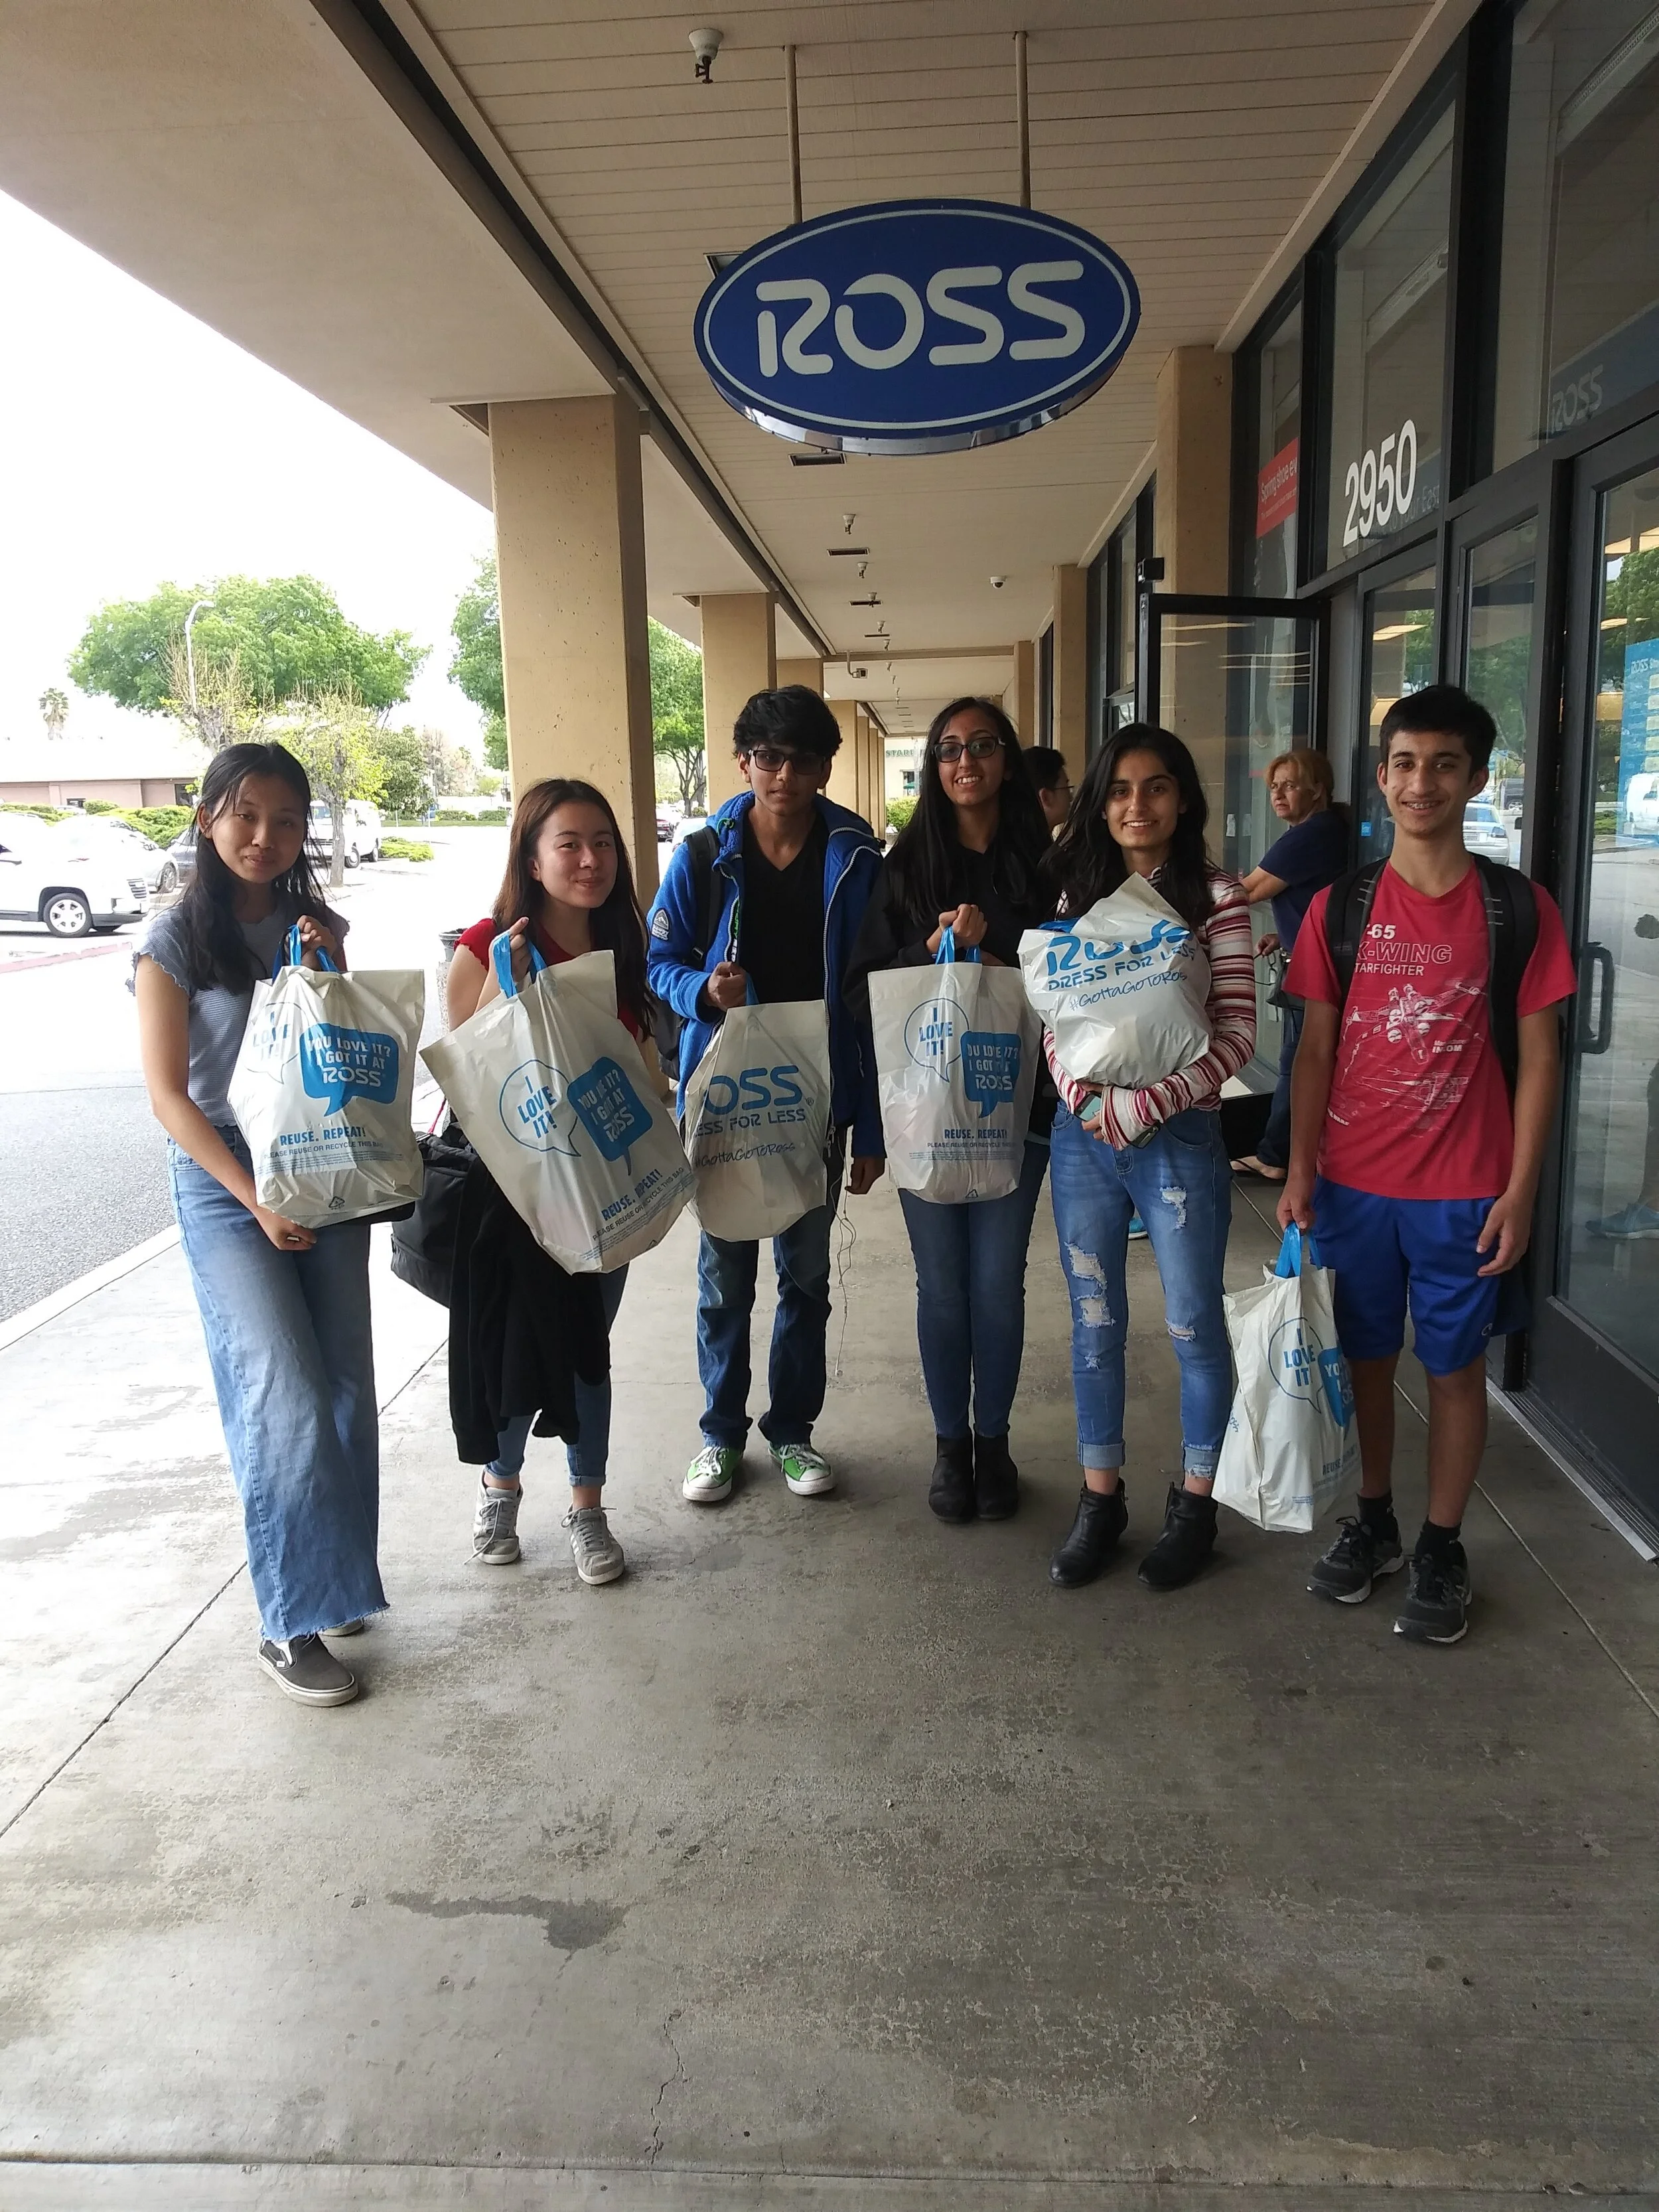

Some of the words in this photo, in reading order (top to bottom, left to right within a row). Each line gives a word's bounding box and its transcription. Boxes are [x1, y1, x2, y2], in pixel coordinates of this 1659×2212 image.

[756, 260, 1086, 378] ROSS
[1551, 364, 1603, 435] ROSS
[1343, 419, 1417, 547] 2950
[1366, 923, 1397, 940] -65
[1358, 941, 1453, 964] X-WING
[1048, 964, 1108, 991] DRESS
[1115, 956, 1155, 976] FOR
[1354, 962, 1425, 976] TARFIGHTER
[933, 1007, 938, 1023] I
[919, 1021, 954, 1043] LOVE
[336, 1037, 368, 1052] LOVE
[372, 1043, 391, 1057] IT?
[926, 1039, 944, 1057] IT!
[1004, 1046, 1019, 1059] IT?
[325, 1051, 350, 1064] GOT
[355, 1054, 368, 1066] IT
[372, 1057, 385, 1070] AT
[969, 1060, 973, 1071] I
[976, 1060, 993, 1071] GOT
[323, 1066, 382, 1087] ROSS
[525, 1075, 534, 1094] I
[605, 1069, 620, 1088] IT?
[975, 1074, 1013, 1090] ROSS
[703, 1065, 803, 1116] OSS
[518, 1085, 557, 1124] LOVE
[591, 1112, 599, 1125] I
[613, 1088, 625, 1105] AT
[532, 1110, 557, 1139] IT!
[730, 1114, 761, 1130] FOR
[768, 1108, 806, 1124] LESS
[279, 1131, 319, 1146] REUSE.
[323, 1126, 366, 1141] REPEAT!
[944, 1129, 974, 1139] REUSE.
[977, 1129, 1007, 1139] REPEAT!
[264, 1150, 287, 1159] PLEASE
[289, 1146, 312, 1155] REUSE
[325, 1140, 356, 1151] RECYCLE
[601, 1194, 636, 1221] REUSE.
[614, 1211, 635, 1226] REUSE
[634, 1204, 644, 1213] OR
[644, 1187, 663, 1208] CYCLE
[1297, 1328, 1303, 1346] I
[1283, 1344, 1316, 1368] LOVE
